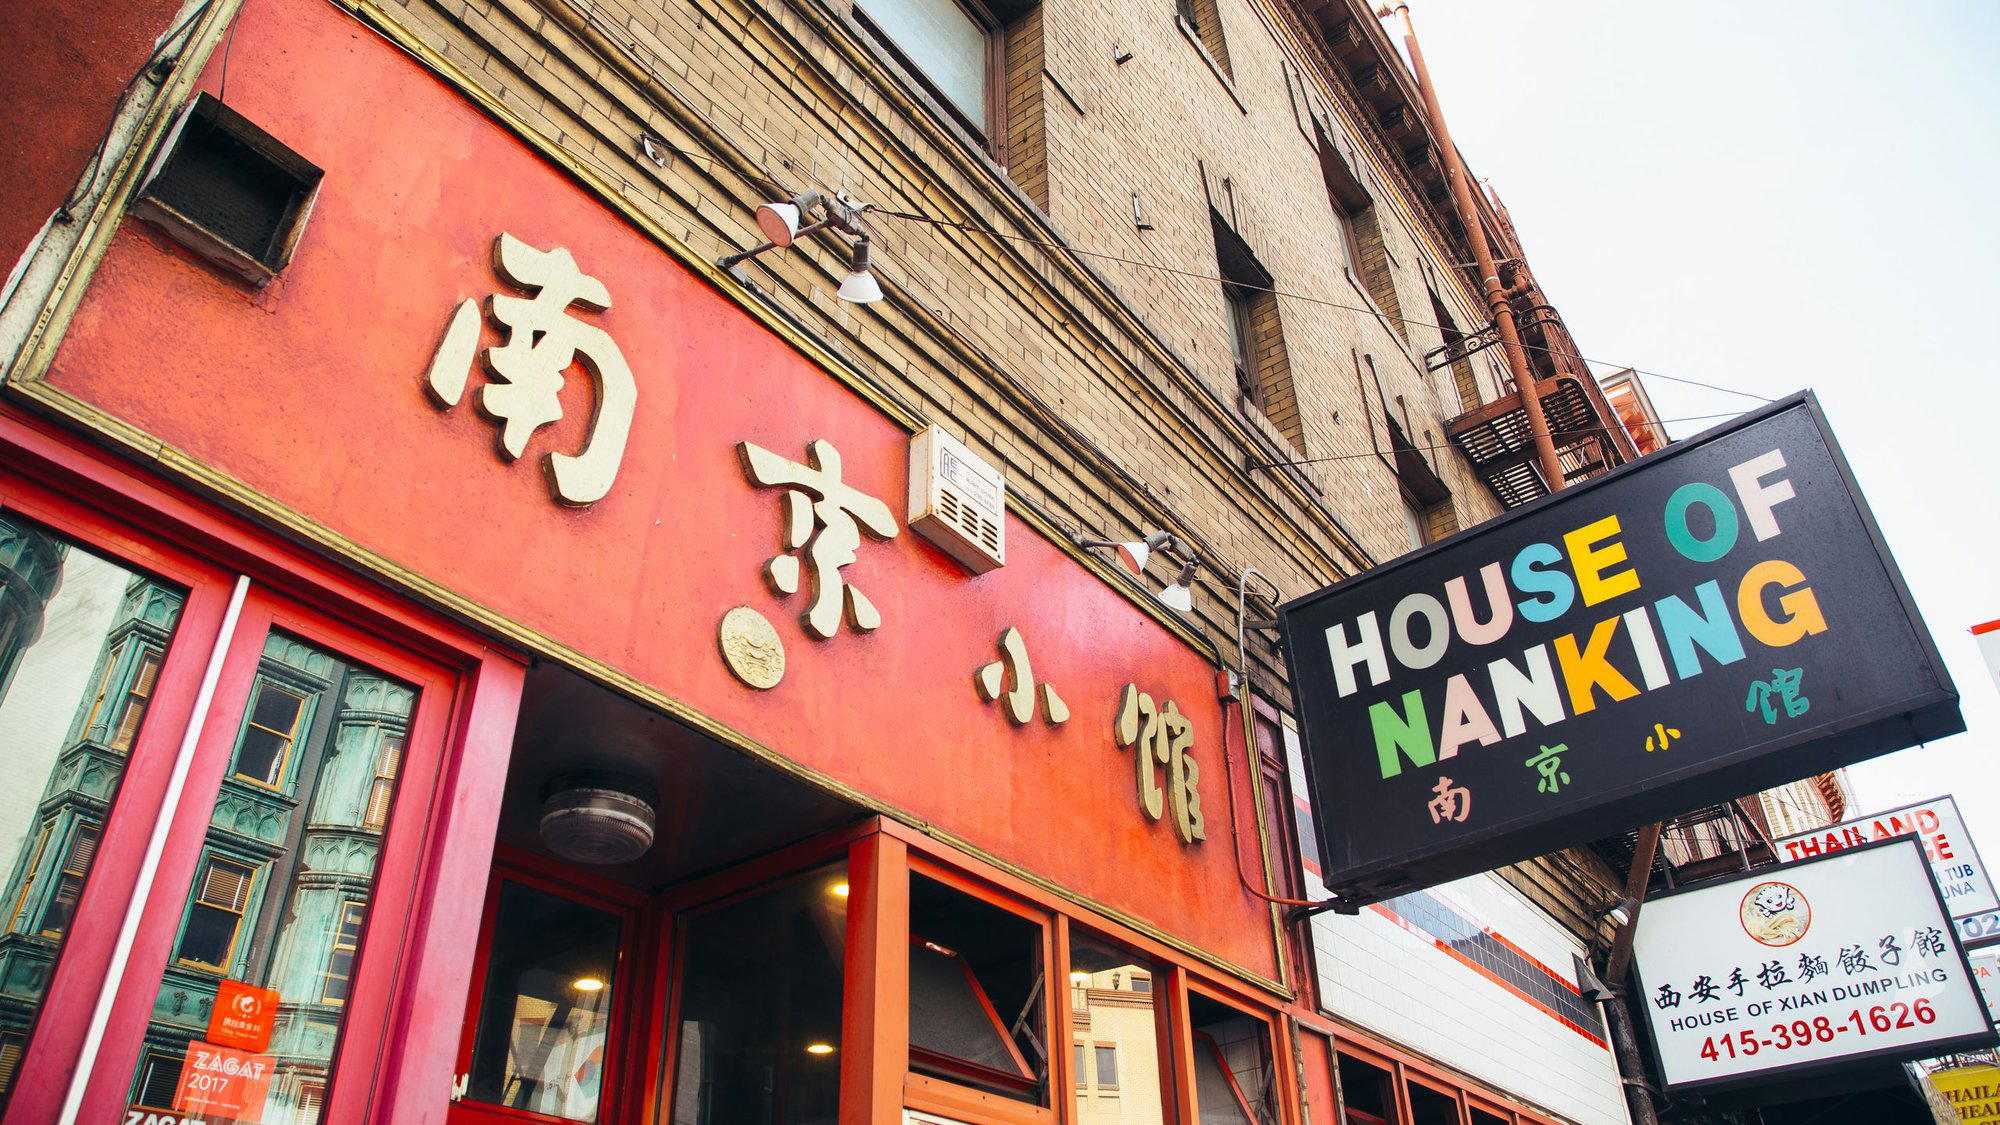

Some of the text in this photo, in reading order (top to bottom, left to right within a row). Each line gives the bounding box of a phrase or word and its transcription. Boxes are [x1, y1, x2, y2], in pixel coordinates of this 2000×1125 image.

[1324, 448, 1797, 698] HOUSE OF
[1367, 559, 1828, 780] NANKING
[1944, 882, 1976, 899] UNA
[1945, 864, 1974, 881] TUB
[1671, 968, 1948, 1032] HOUSE OF XIAN DUMPLING
[1700, 997, 1937, 1062] 415-398-1626
[188, 1073, 229, 1093] 2017
[193, 1051, 266, 1080] ZAGAT
